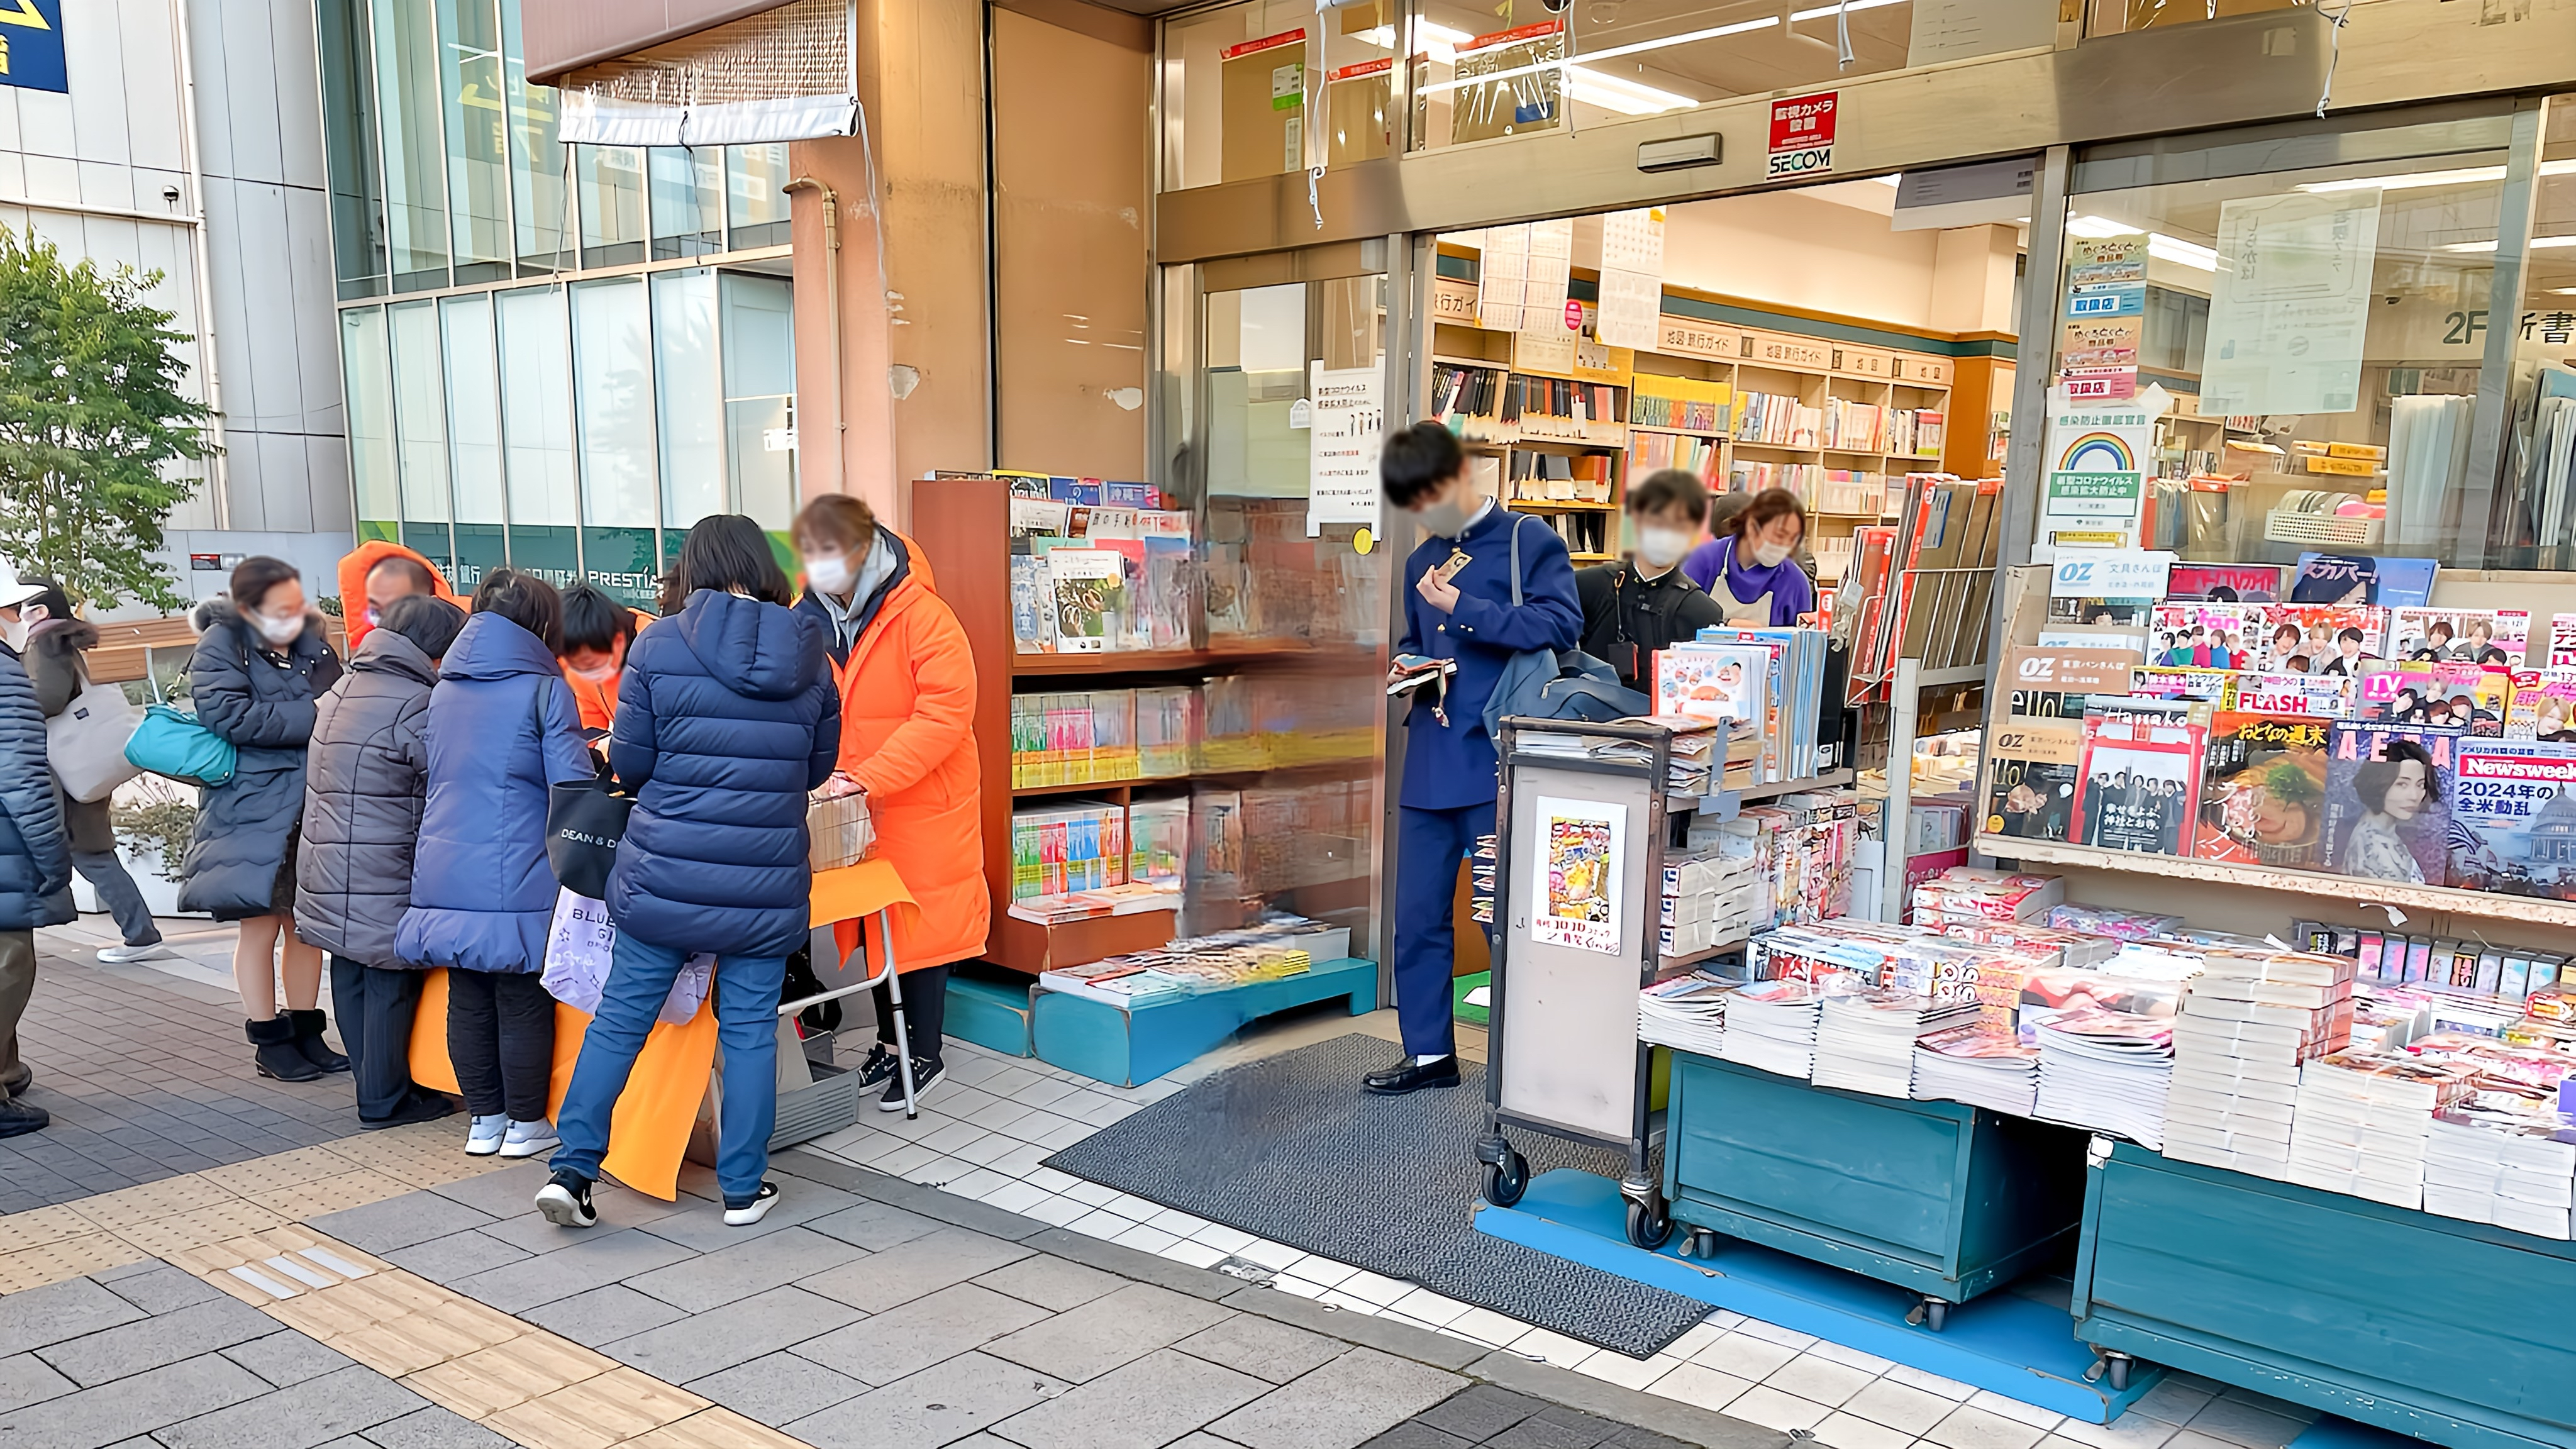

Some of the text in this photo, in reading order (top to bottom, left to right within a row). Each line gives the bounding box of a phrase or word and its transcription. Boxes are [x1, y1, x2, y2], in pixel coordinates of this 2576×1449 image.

[1770, 148, 1831, 174] SECOM
[2443, 310, 2489, 344] 2F
[2059, 563, 2094, 581] OZ
[2019, 657, 2056, 677] OZ
[2240, 692, 2307, 713] FLASH
[2104, 708, 2188, 728] Hanako
[1999, 734, 2024, 747] OZ
[2458, 782, 2553, 800] 2024年の
[2457, 797, 2531, 816] 全米動乱
[562, 829, 594, 843] DEAN
